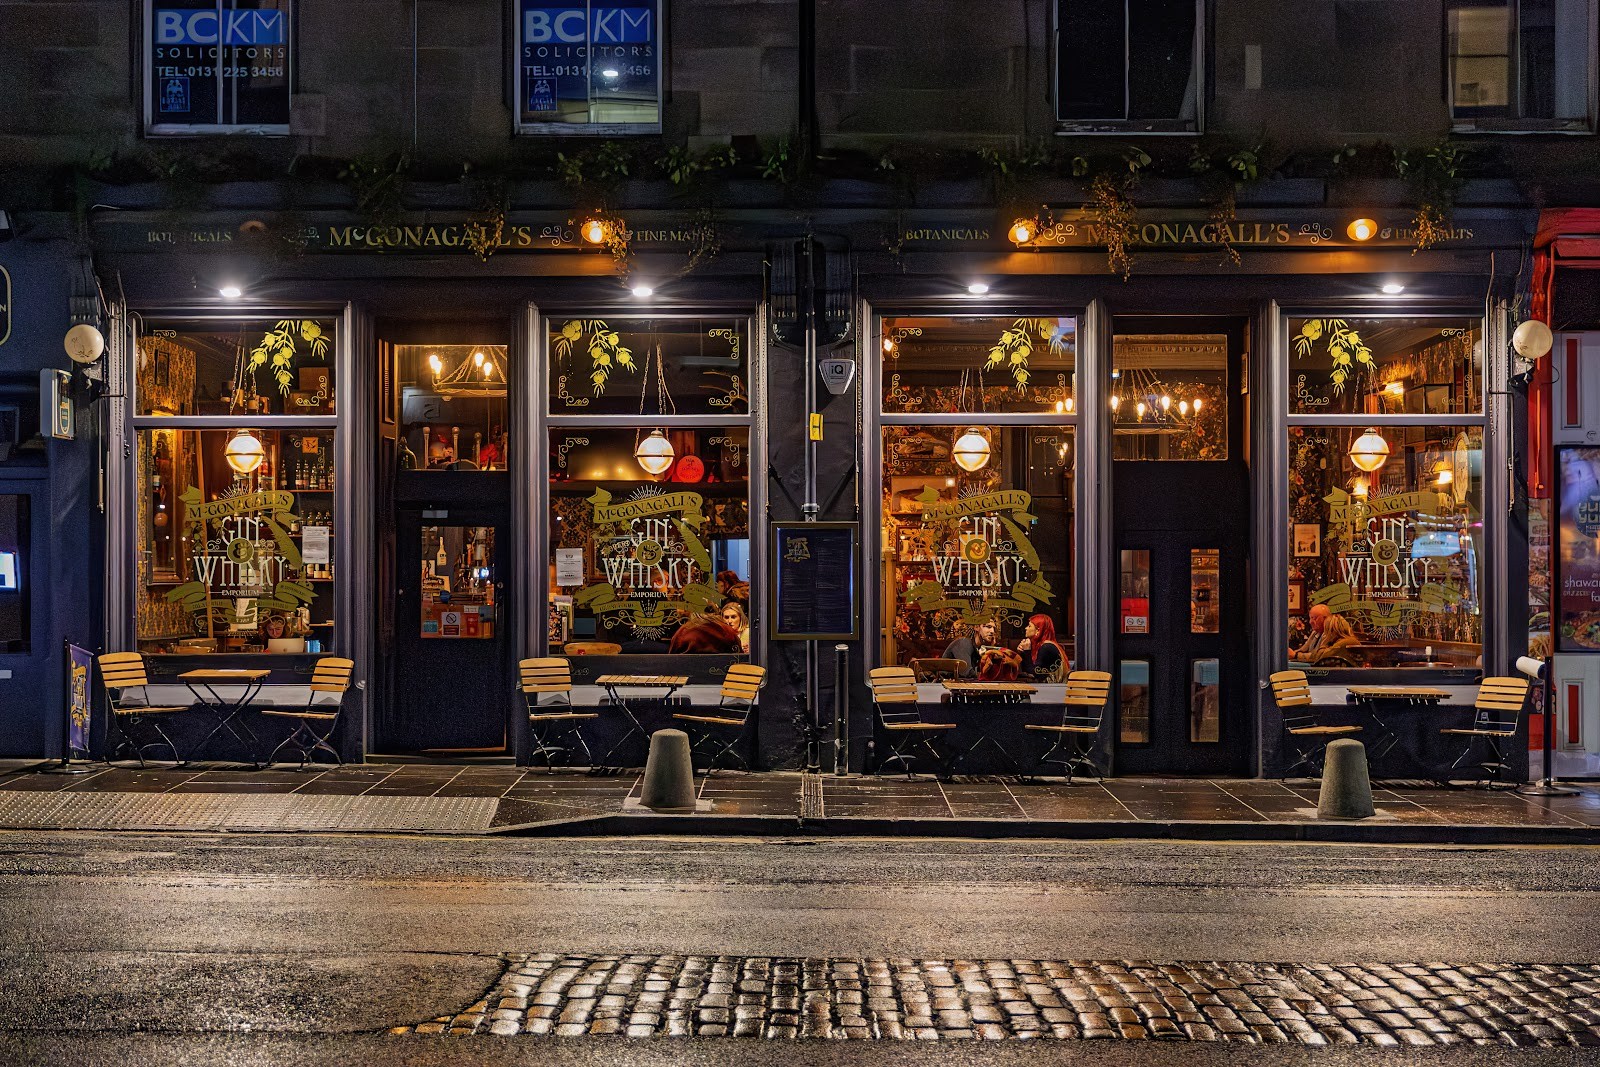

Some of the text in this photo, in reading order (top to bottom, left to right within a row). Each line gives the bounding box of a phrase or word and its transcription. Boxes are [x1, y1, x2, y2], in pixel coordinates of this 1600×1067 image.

[157, 10, 283, 43] BCKM
[525, 9, 650, 42] BCKM
[156, 47, 284, 59] SOLICITORS
[524, 46, 652, 58] SOLICITORS
[223, 66, 248, 77] 225
[147, 231, 232, 243] BOTICALS
[637, 229, 667, 242] FINE
[905, 229, 990, 241] BOTANICALS
[1083, 223, 1290, 244] MGONAGALL'S
[831, 364, 844, 375] iQ
[222, 516, 262, 547] GIN
[630, 518, 671, 549] GIN
[958, 516, 998, 547] GIN
[1366, 517, 1407, 549] GIN
[1377, 544, 1396, 561] &
[193, 556, 287, 587] WHISKY
[602, 557, 696, 589] WHISKY
[931, 556, 1024, 587] WHISKY
[1338, 557, 1432, 589] WHISKY
